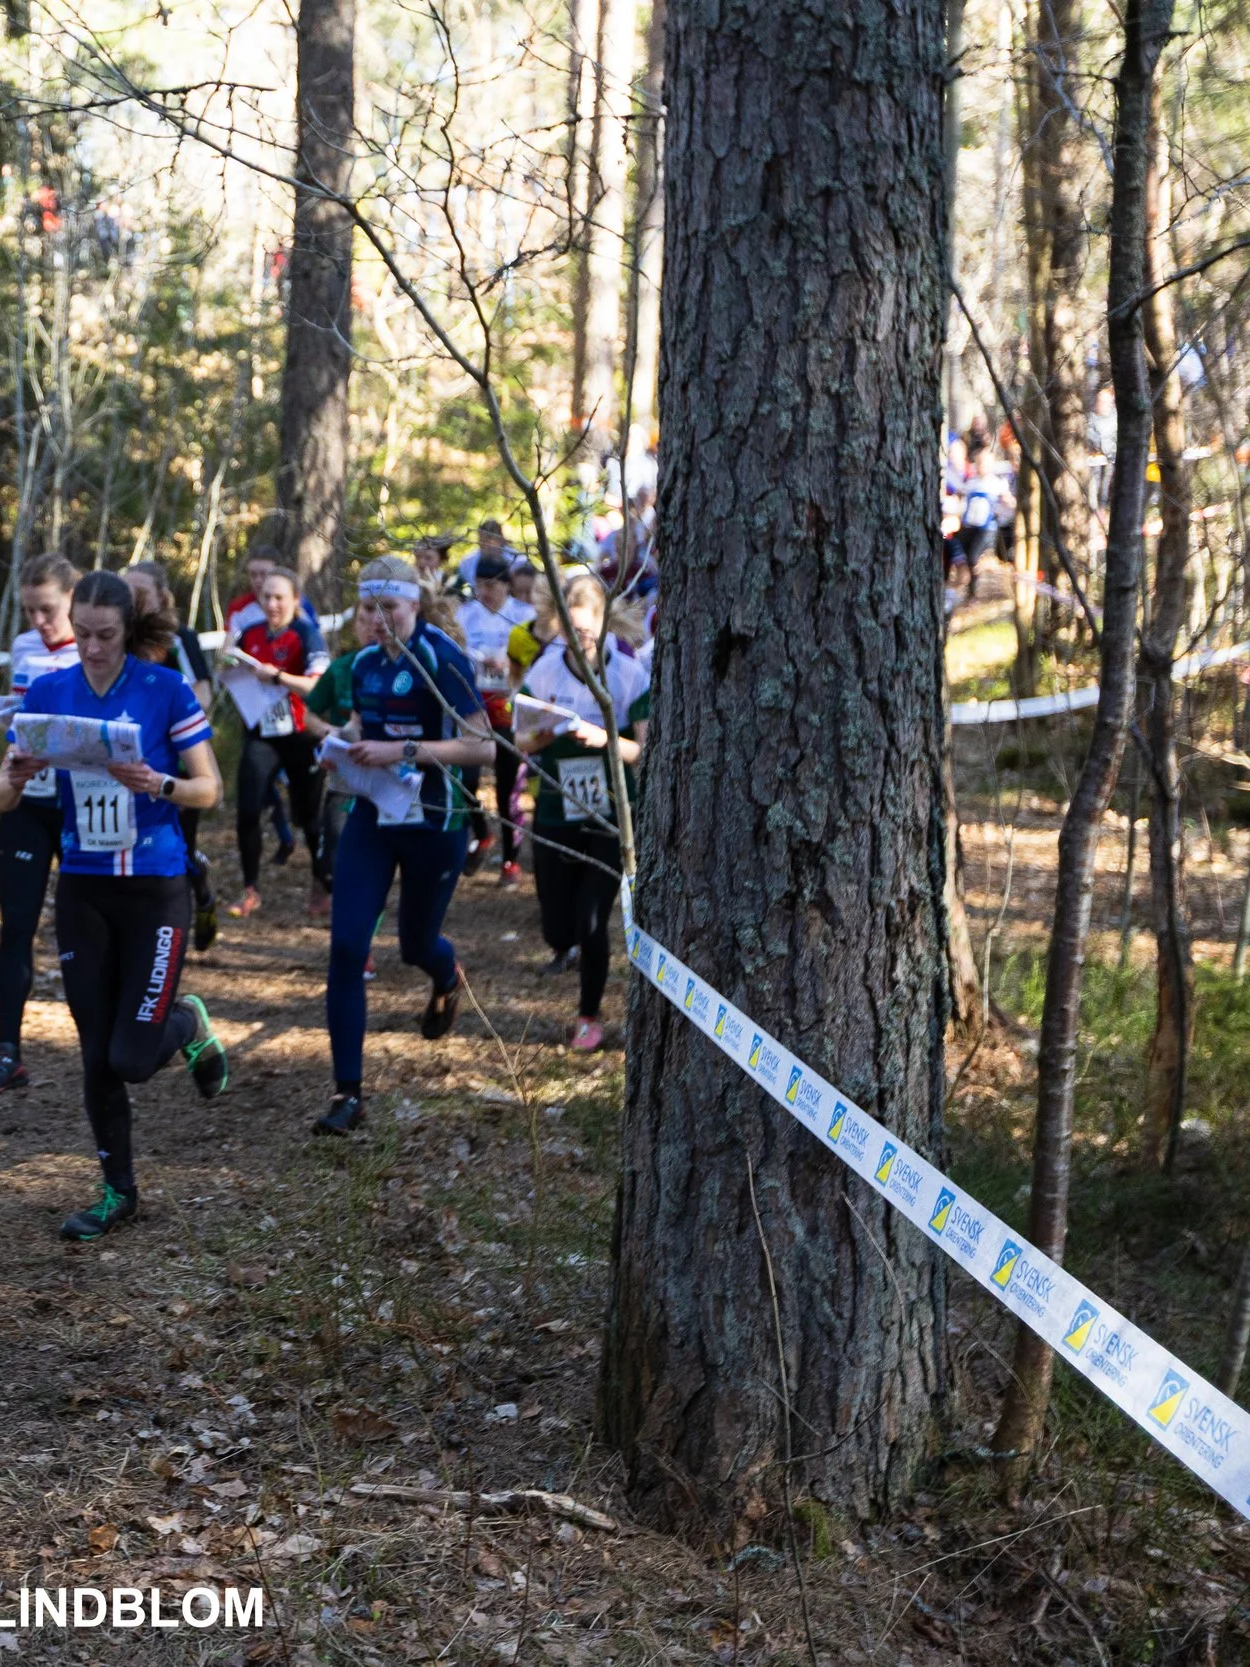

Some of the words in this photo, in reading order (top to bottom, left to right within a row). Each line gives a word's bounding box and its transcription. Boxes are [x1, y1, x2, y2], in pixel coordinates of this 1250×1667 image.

[84, 794, 119, 833] 111
[147, 925, 174, 993] LIDINGÖ
[135, 995, 160, 1022] IFK
[799, 1079, 823, 1106] SVENSK
[844, 1116, 870, 1148] SVENSK
[889, 1178, 917, 1207] ORIENTERING
[894, 1158, 924, 1193] SVENSK
[945, 1227, 977, 1259] ORIENTERING
[951, 1206, 985, 1245] SVENSK
[1010, 1282, 1047, 1318] ORIENTERING
[1017, 1260, 1056, 1303] SVENSK
[1094, 1323, 1139, 1371] SVENSK
[1084, 1347, 1128, 1388] ORIENTERING
[1184, 1397, 1238, 1452] SVENSK
[1173, 1421, 1225, 1469] ORIENTERING
